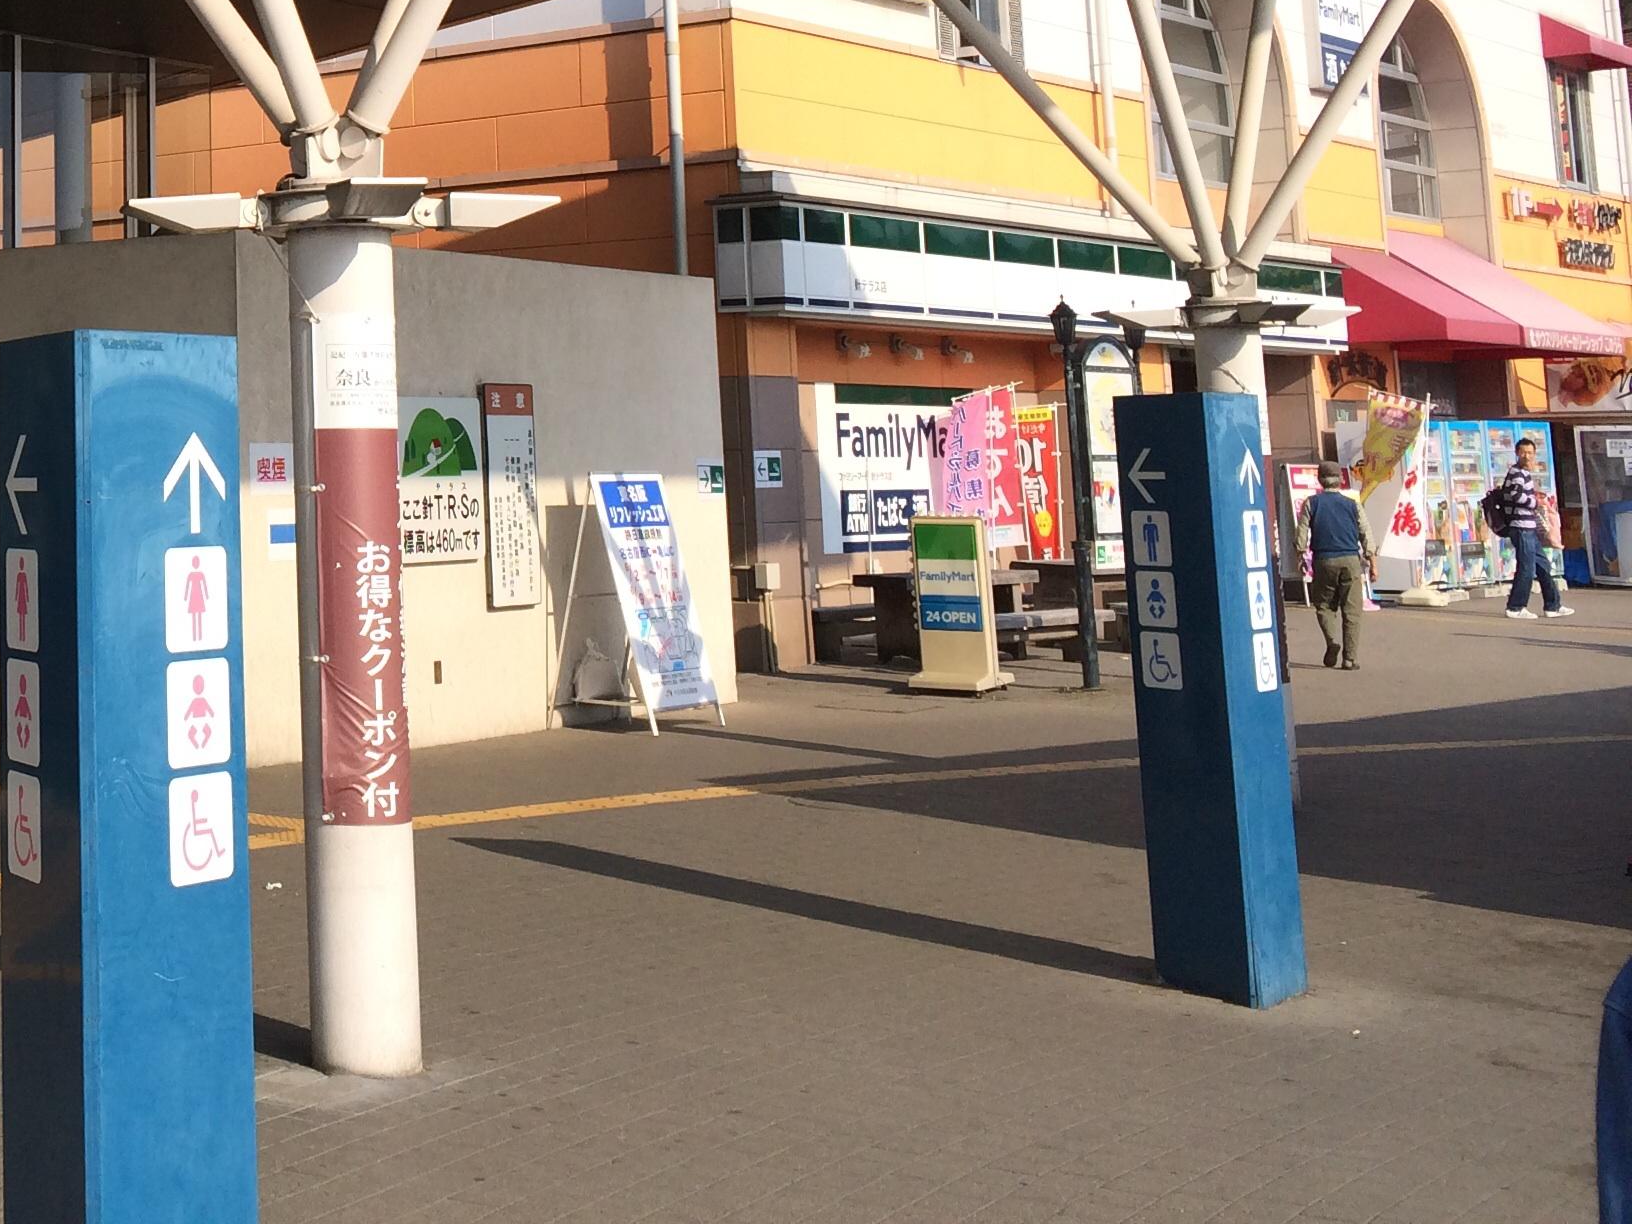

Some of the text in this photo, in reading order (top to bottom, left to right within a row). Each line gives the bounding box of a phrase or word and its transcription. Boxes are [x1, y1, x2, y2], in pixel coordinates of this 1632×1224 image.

[1318, 0, 1360, 27] FamilyMart
[257, 457, 286, 481] 喫煙
[848, 493, 866, 512] 銀行
[877, 495, 909, 528] たばこ
[847, 515, 869, 533] ATM
[919, 570, 976, 584] FamilyMart
[355, 539, 401, 819] お得なクーポン付
